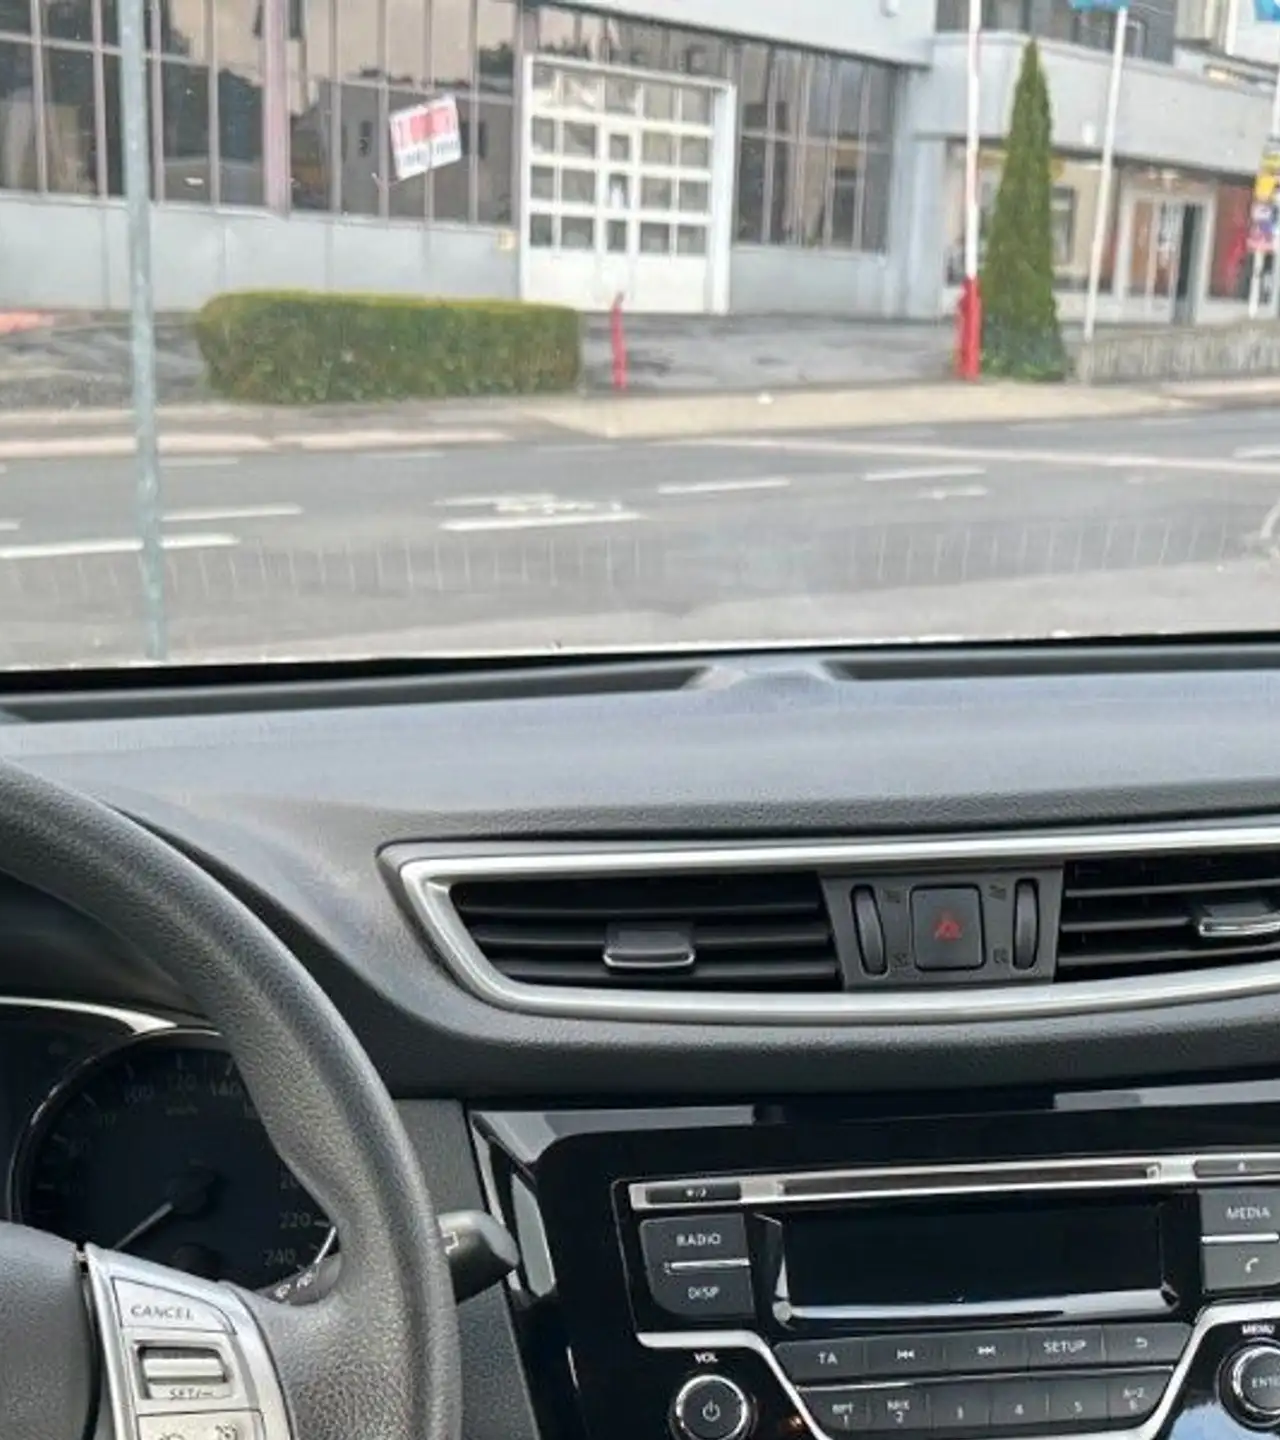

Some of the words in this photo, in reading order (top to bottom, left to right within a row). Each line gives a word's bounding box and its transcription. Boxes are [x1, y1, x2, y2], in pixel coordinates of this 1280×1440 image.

[1226, 1206, 1271, 1220] MEDIA
[676, 1233, 721, 1247] RADIO
[687, 1286, 719, 1300] DISP
[130, 1303, 194, 1320] CANCEL
[1241, 1323, 1276, 1335] MENU
[1043, 1339, 1088, 1354] SETUP
[693, 1352, 719, 1364] VOL
[818, 1352, 838, 1365] TA
